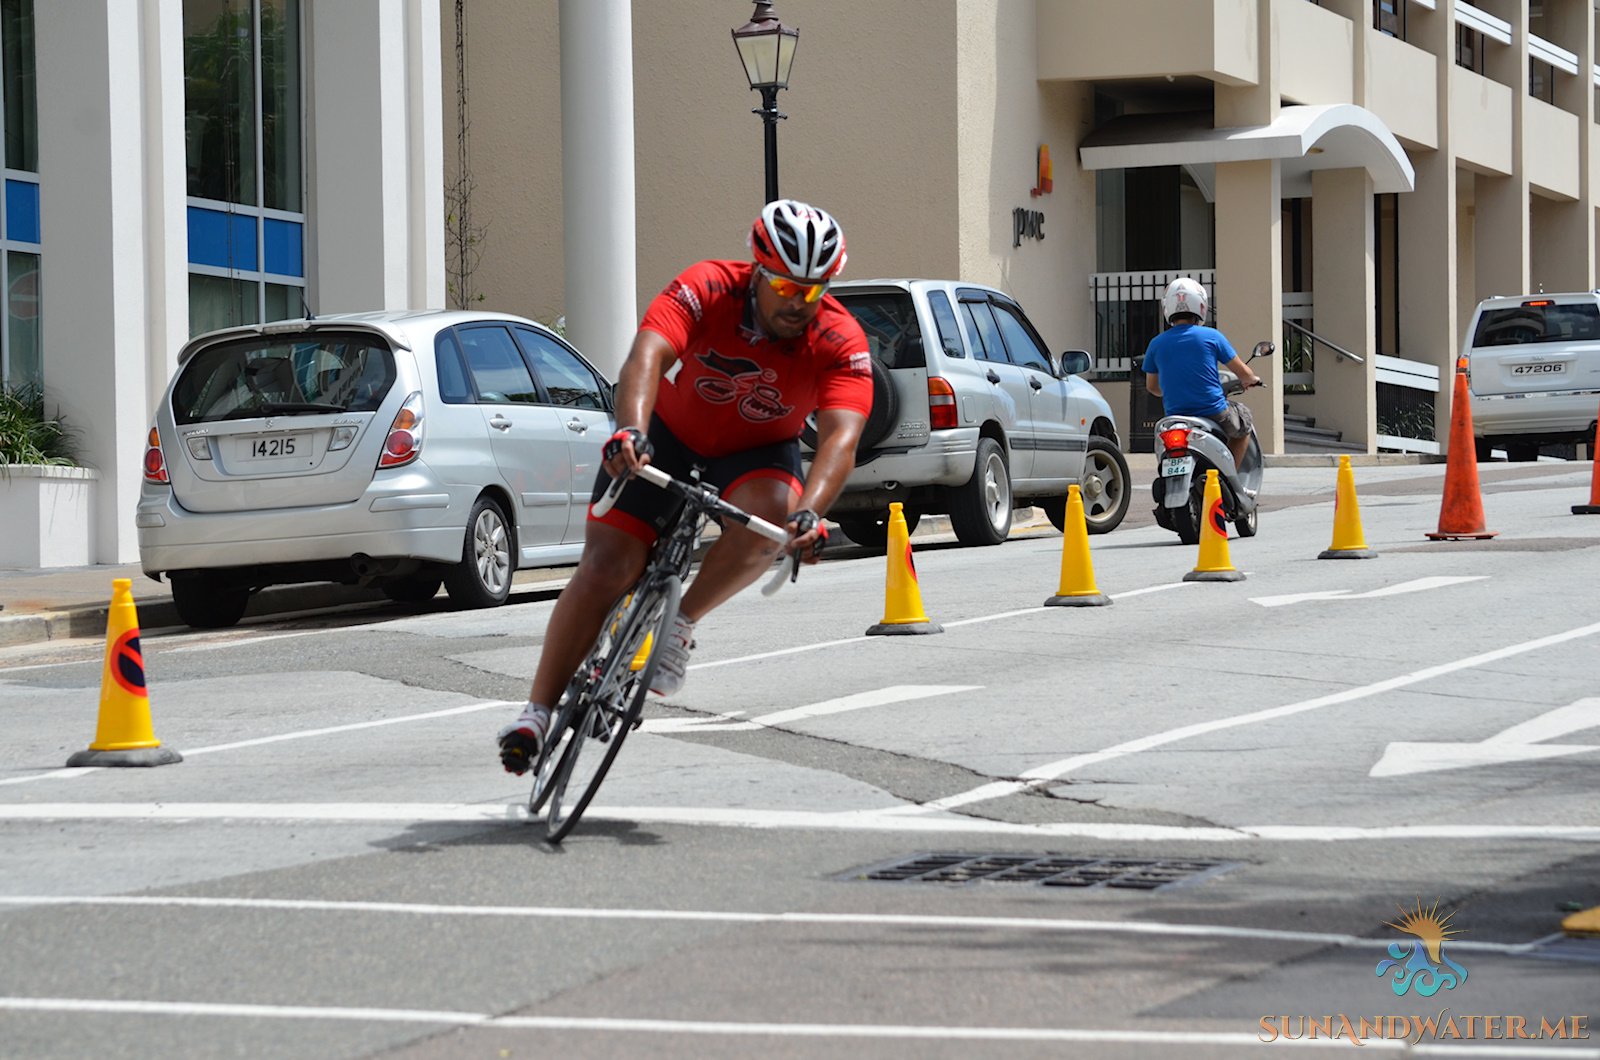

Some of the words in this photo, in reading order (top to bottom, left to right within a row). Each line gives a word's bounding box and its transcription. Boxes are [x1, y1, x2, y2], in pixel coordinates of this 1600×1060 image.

[1012, 207, 1045, 249] pwc
[1515, 364, 1562, 374] 47206
[252, 438, 296, 457] 14215
[1167, 466, 1186, 475] 844
